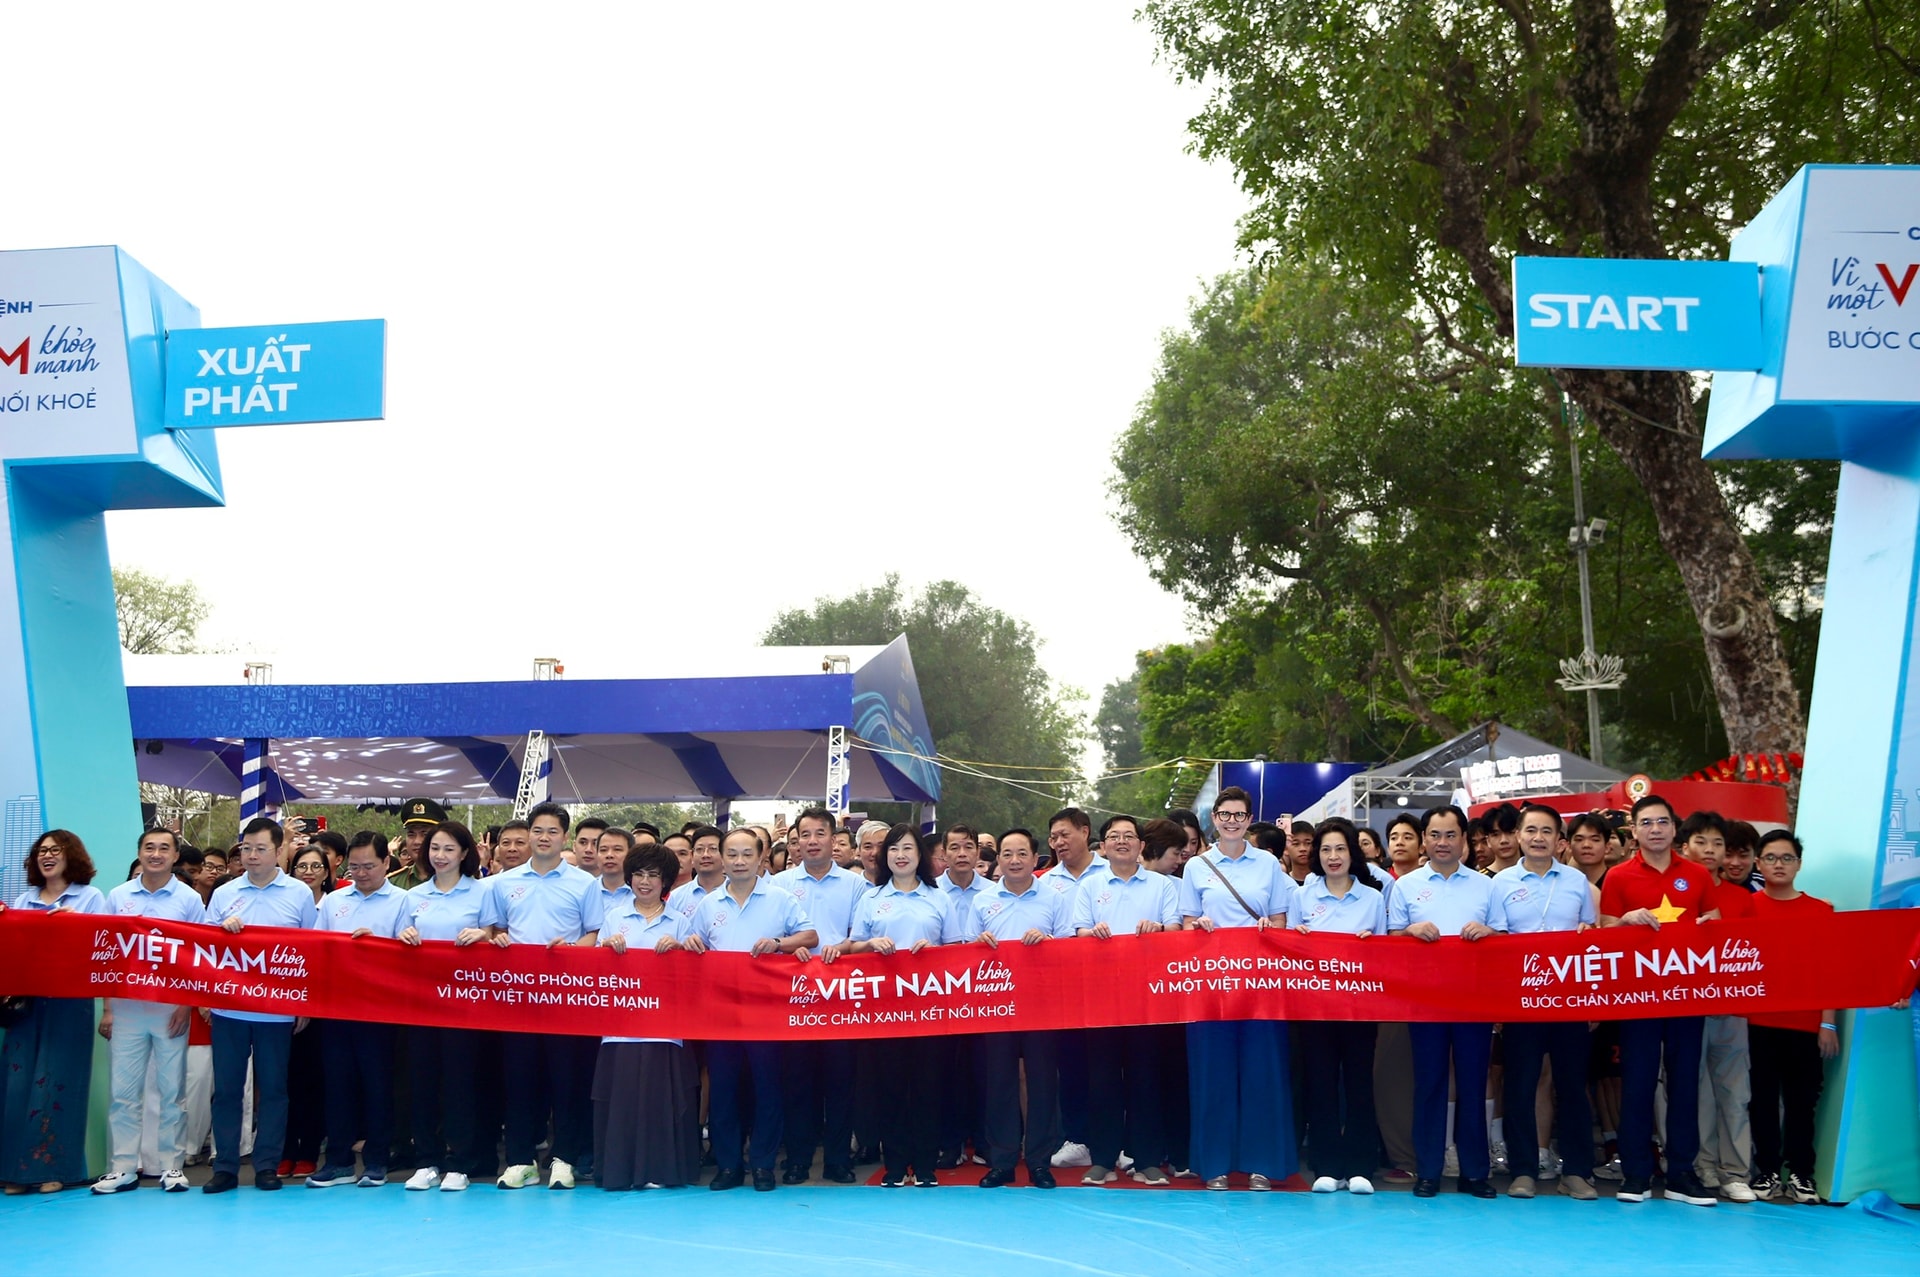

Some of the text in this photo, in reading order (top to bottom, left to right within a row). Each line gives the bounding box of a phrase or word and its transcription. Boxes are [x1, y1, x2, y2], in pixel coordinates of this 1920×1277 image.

[1832, 256, 1860, 286] Vì
[1827, 281, 1885, 317] một
[1529, 293, 1699, 331] START
[39, 324, 96, 355] khỏe
[1828, 326, 1900, 349] BƯỚC
[34, 343, 100, 379] mạnh
[197, 334, 310, 376] XUẤT
[37, 387, 97, 411] KHOẺ
[184, 375, 298, 416] PHÁT
[94, 929, 109, 947] Vì
[116, 927, 267, 974] VIỆT NAM
[91, 944, 121, 965] một
[1167, 955, 1363, 975] CHỦ ĐỘNG PHÒNG BỆNH
[1523, 953, 1540, 973] Vì
[1548, 944, 1717, 990] VIỆT NAM
[1719, 951, 1764, 977] mạnh
[269, 959, 308, 980] mạnh
[454, 967, 641, 991] CHỦ ĐỘNG PHÒNG BỆNH
[1521, 968, 1554, 991] một
[90, 969, 124, 983] BƯỚC
[126, 972, 166, 988] CHÂN
[169, 977, 210, 994] XANH,
[214, 980, 239, 995] KẾT
[241, 983, 268, 998] NỐI
[791, 974, 807, 992] Vì
[815, 967, 971, 1009] VIỆT NAM
[974, 972, 1015, 997] mạnh
[1149, 975, 1384, 995] VÌ MỘT VIỆT NAM KHỎE MẠNH
[437, 984, 660, 1011] VÌ MỘT VIỆT NAM KHỎE MẠNH
[789, 990, 820, 1008] một
[1521, 994, 1563, 1009] BƯỚC
[1566, 993, 1609, 1007] CHÂN
[1612, 990, 1660, 1005] XANH,
[1662, 985, 1689, 1001] KẾT
[1692, 983, 1721, 999] NỐI
[789, 1012, 828, 1026] BƯỚC
[831, 1011, 870, 1025] CHÂN
[874, 1010, 917, 1024] XANH,
[920, 1005, 945, 1021] KẾT
[948, 1003, 974, 1019] NỐI
